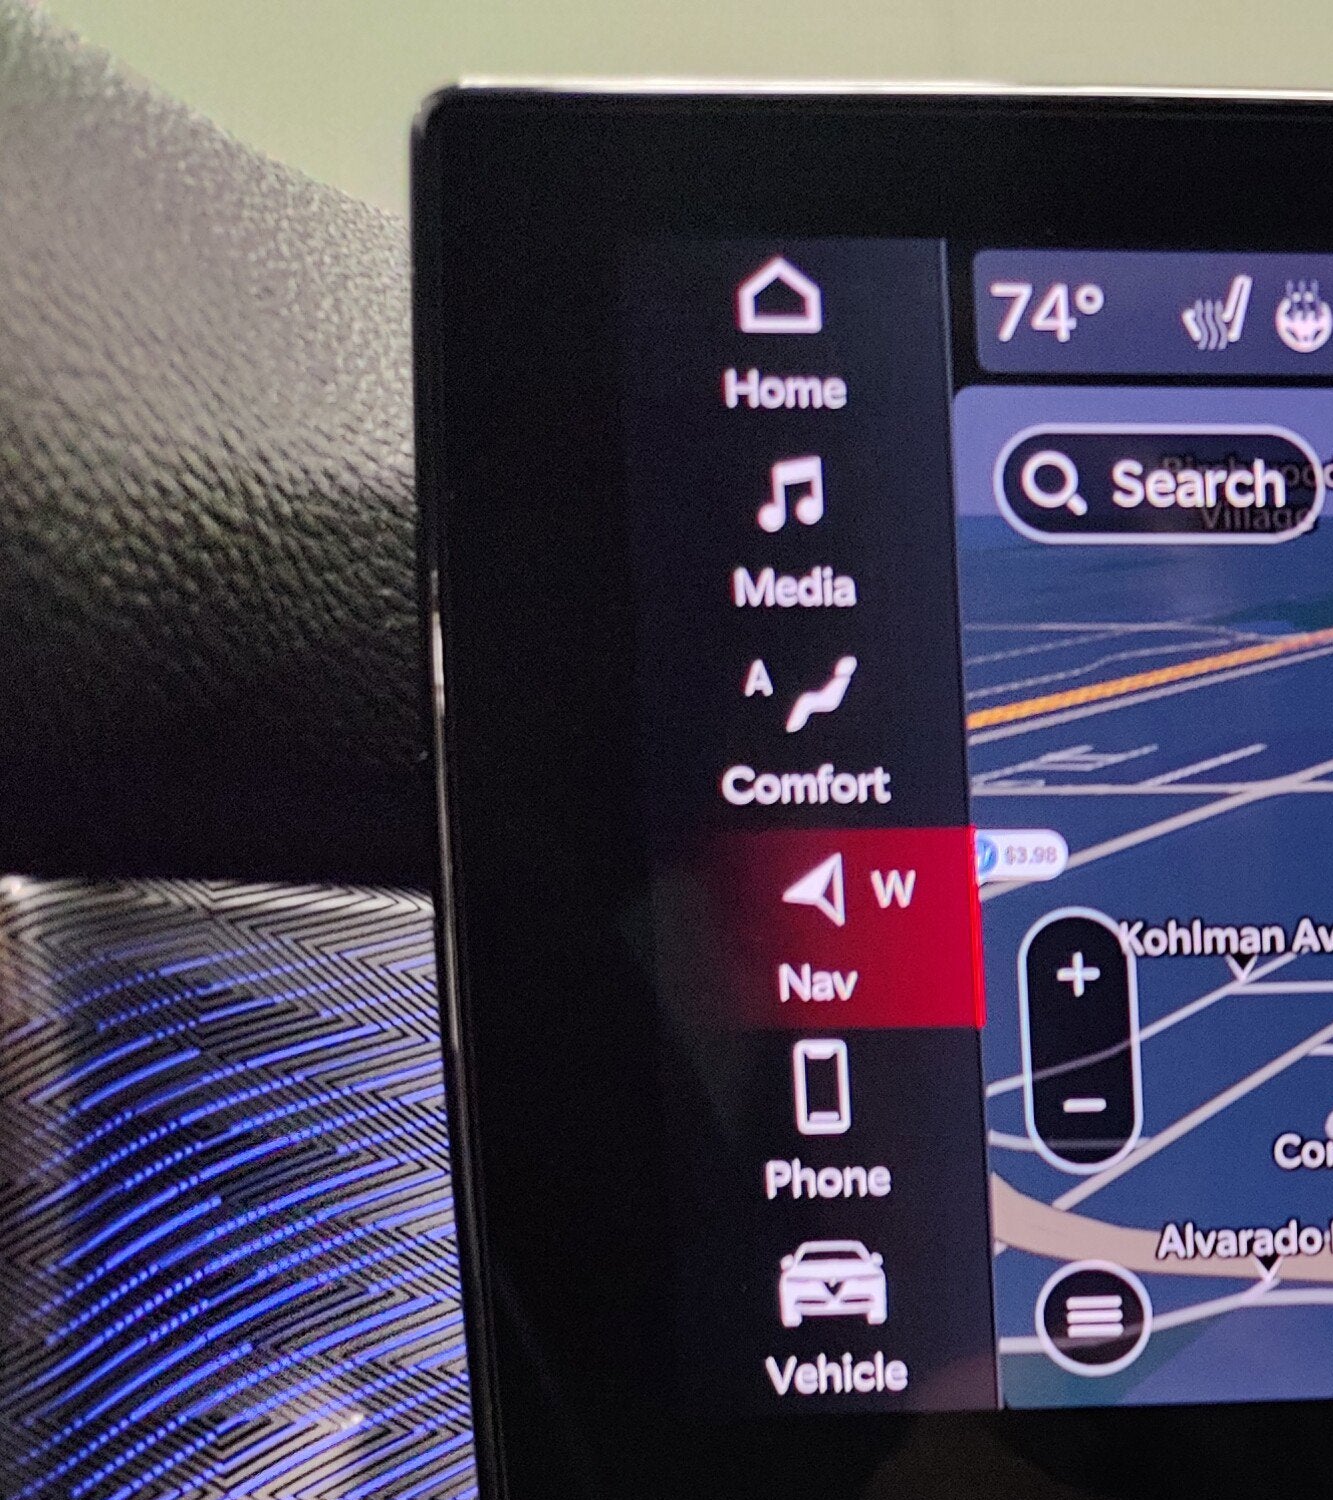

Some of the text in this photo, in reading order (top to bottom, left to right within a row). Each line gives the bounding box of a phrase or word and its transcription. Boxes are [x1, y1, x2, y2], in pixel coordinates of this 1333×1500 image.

[989, 282, 1105, 342] 74°
[723, 368, 848, 410] Home
[1112, 458, 1286, 508] Search
[733, 567, 858, 608] Media
[744, 659, 774, 698] A
[721, 764, 892, 806] Comfort
[870, 868, 917, 910] W
[1119, 919, 1287, 958] Kohlman
[778, 963, 858, 1003] Nav
[765, 1159, 893, 1200] Phone
[1156, 1221, 1322, 1260] Alvarado
[765, 1351, 909, 1397] Vehicle
